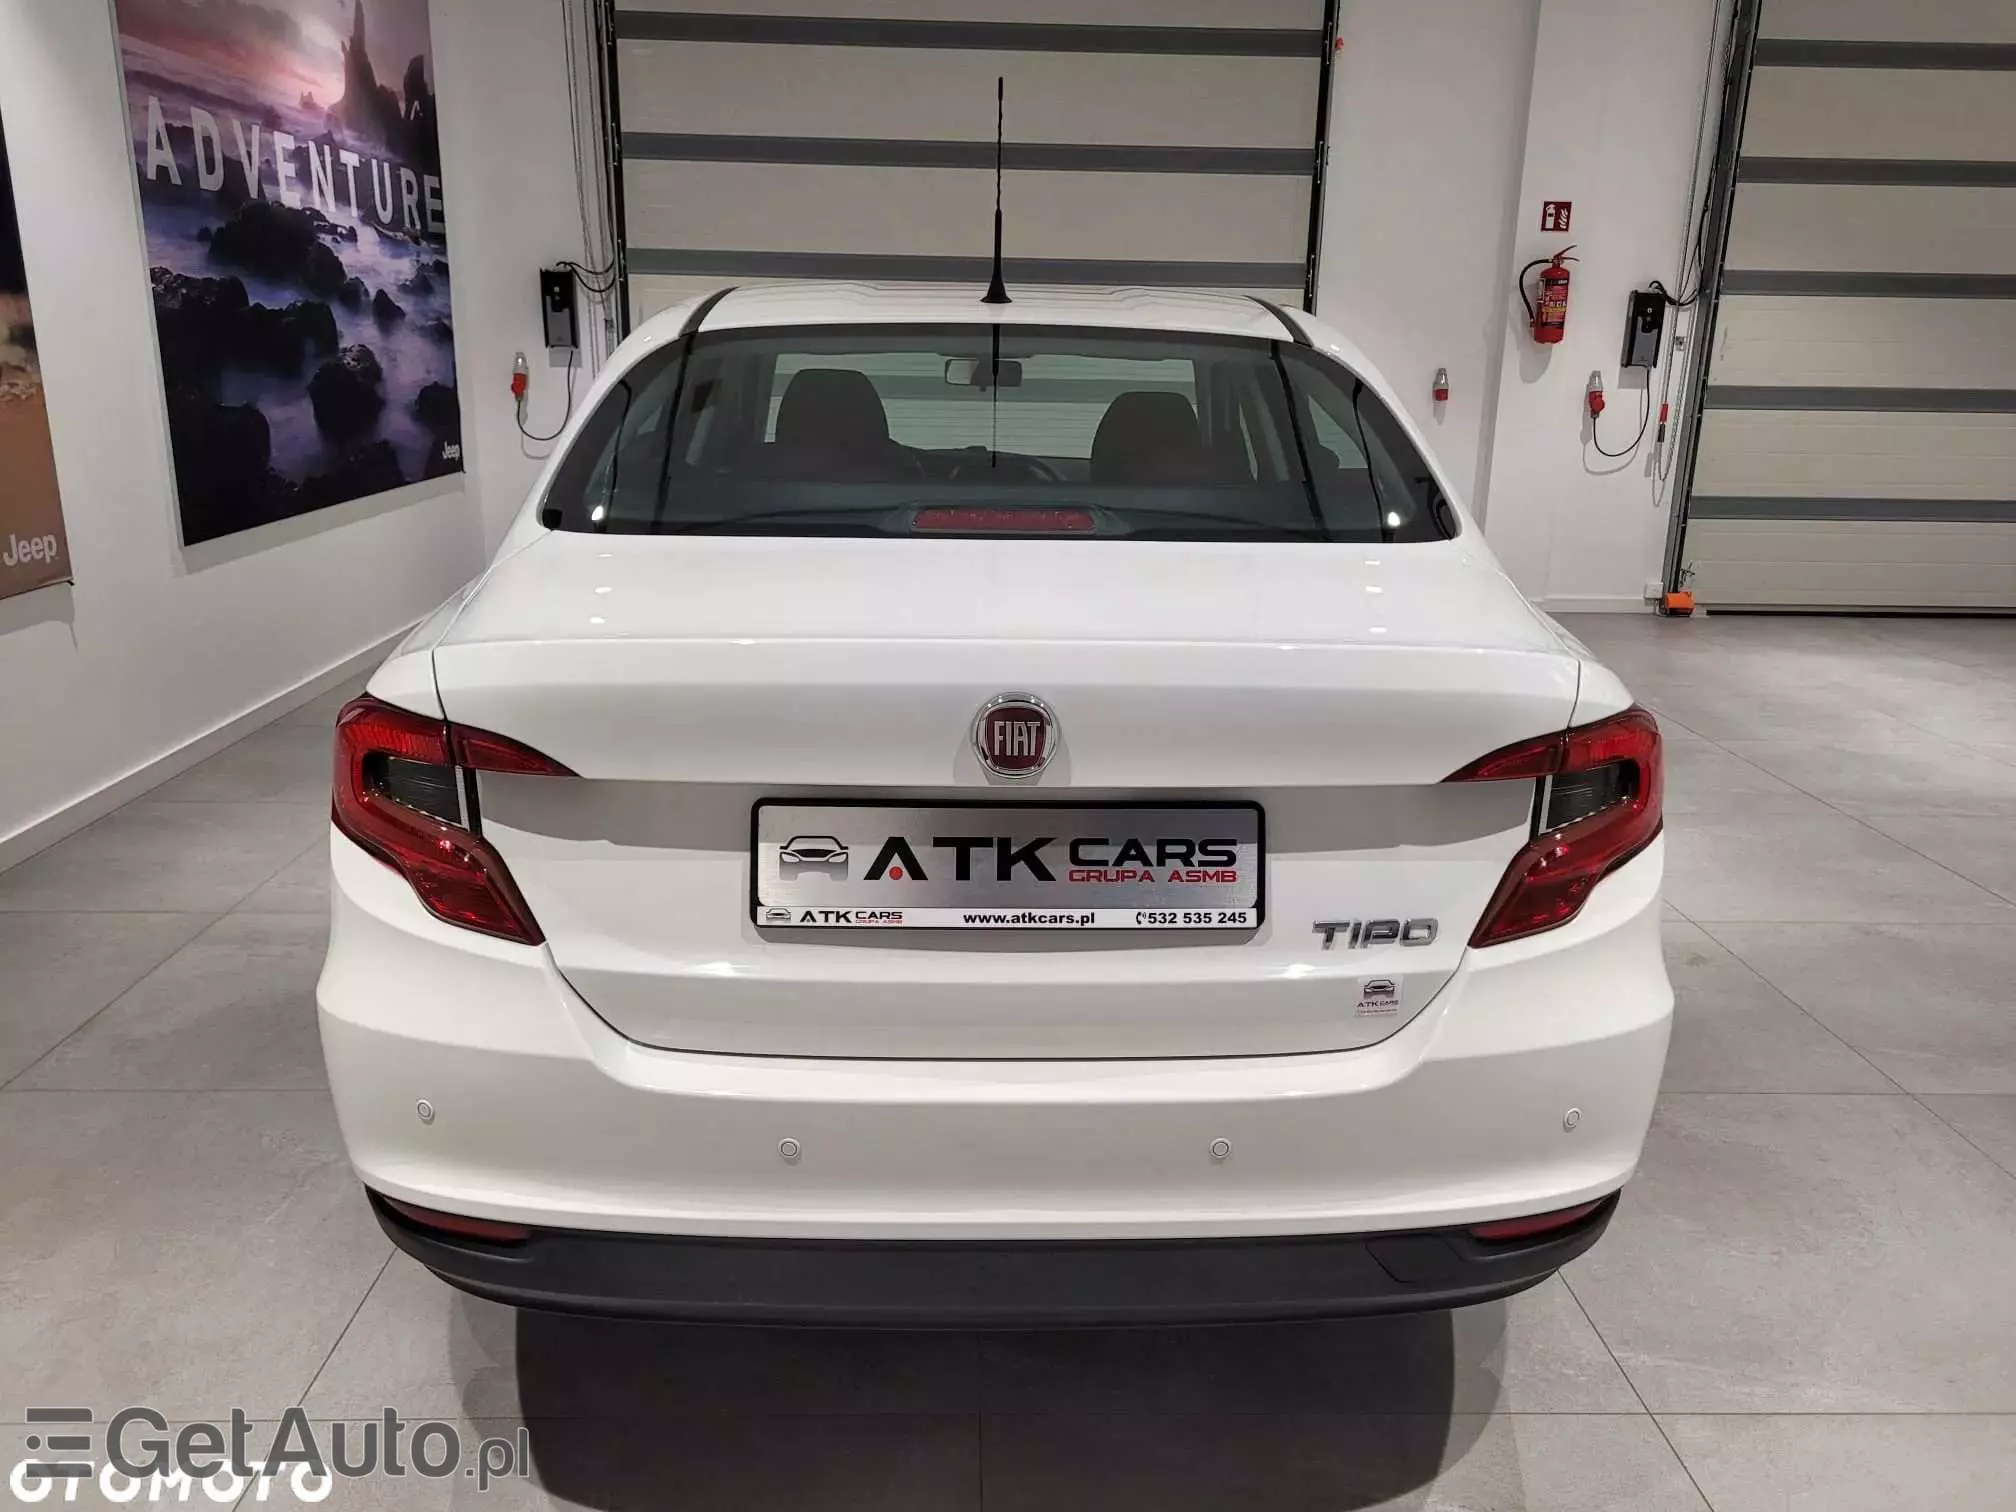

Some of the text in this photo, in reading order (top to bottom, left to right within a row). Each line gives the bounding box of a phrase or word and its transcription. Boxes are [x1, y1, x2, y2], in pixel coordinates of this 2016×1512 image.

[146, 95, 446, 234] ADVENTURE
[442, 440, 460, 461] Jeep
[3, 533, 57, 566] Jeep
[994, 720, 1041, 756] FIAT
[863, 836, 1238, 882] ATK CARS
[1069, 869, 1237, 883] GRUPA ASMB
[800, 910, 903, 923] ATK CARS
[963, 912, 1095, 926] www.atkcars.pl
[1147, 912, 1247, 924] 532 535 245
[1312, 918, 1438, 950] TIPO
